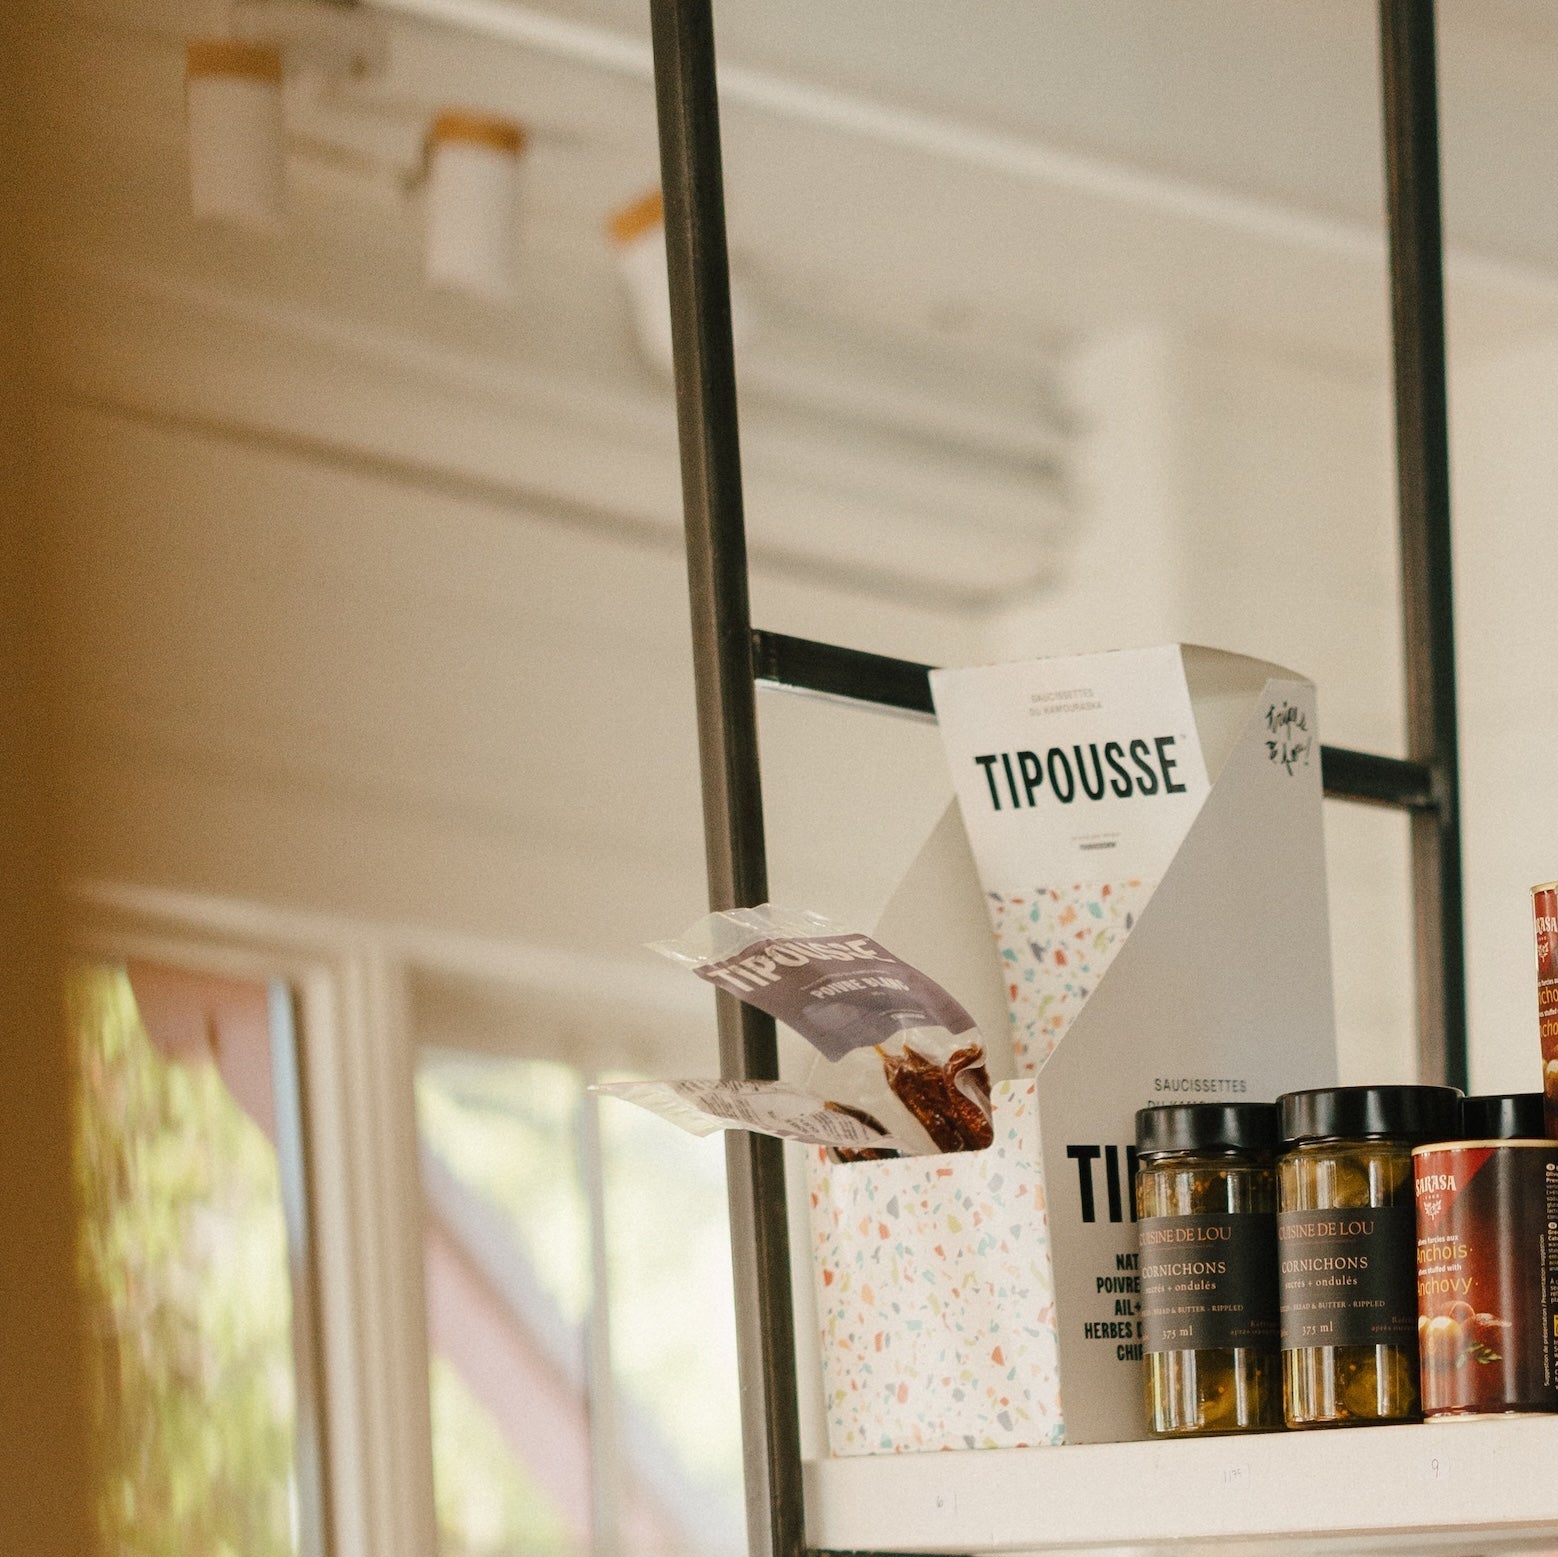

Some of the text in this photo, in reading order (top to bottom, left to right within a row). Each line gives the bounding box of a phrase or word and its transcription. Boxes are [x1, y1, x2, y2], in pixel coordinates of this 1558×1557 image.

[975, 736, 1187, 811] TIPOUSSE
[1154, 1077, 1247, 1094] SAUCISSETTES
[1415, 1174, 1457, 1197] SARASA
[1176, 1227, 1232, 1242] DE LOU
[1279, 1221, 1374, 1240] CUISINE DE LOU
[1142, 1262, 1226, 1279] CORNICHONS
[1282, 1257, 1368, 1274] CORNICHONS
[1447, 1264, 1462, 1272] with
[1097, 1277, 1140, 1293] POIVRE
[1175, 1280, 1216, 1291] ondulés
[1316, 1275, 1358, 1286] ondulés
[1085, 1322, 1131, 1339] HERBES
[1162, 1326, 1193, 1340] 375 ml
[1302, 1322, 1333, 1336] 375 ml
